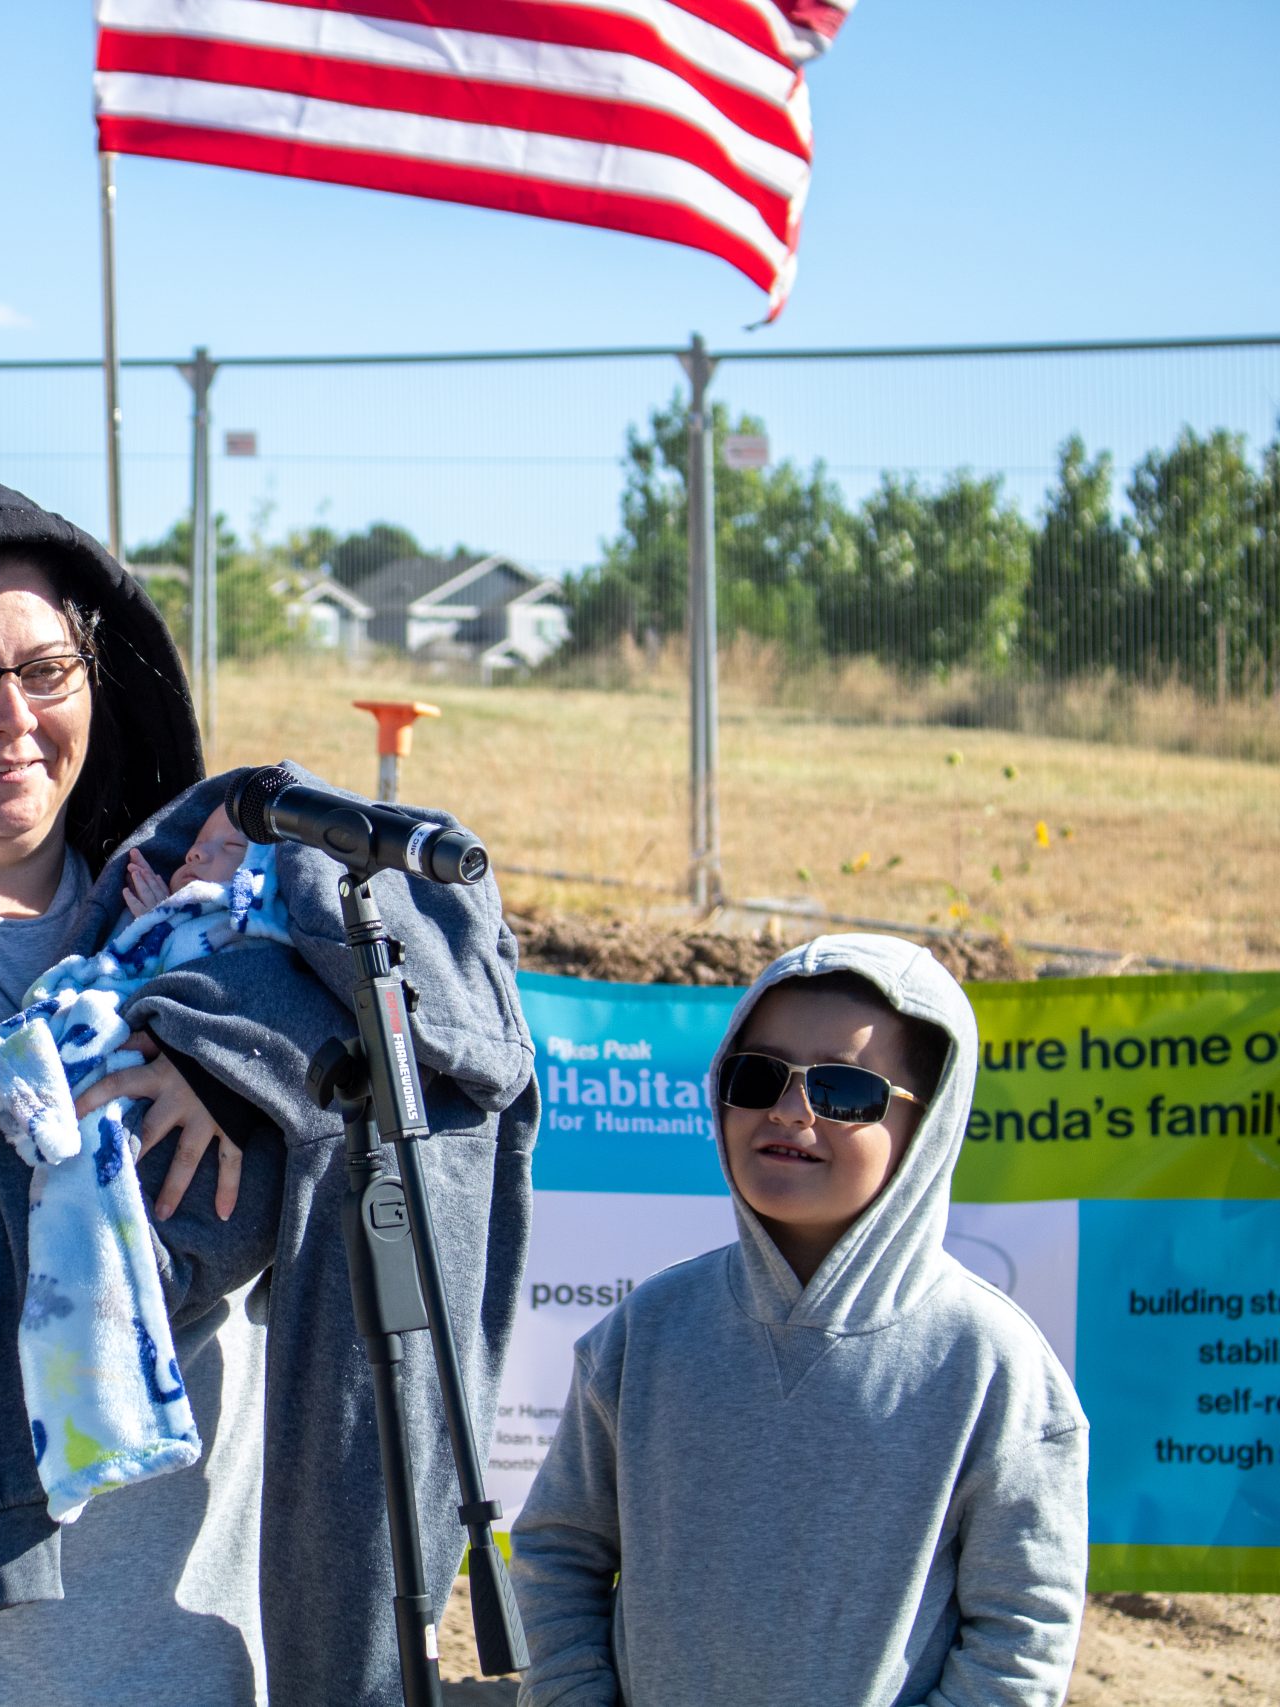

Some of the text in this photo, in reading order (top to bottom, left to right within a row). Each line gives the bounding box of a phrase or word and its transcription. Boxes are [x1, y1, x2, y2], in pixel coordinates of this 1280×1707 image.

[410, 838, 420, 856] MIC
[547, 1036, 652, 1062] Pikes Peak
[977, 1026, 1280, 1071] ure home o
[548, 1108, 716, 1140] for Humanity
[1146, 1094, 1280, 1146] famil
[531, 1278, 634, 1310] possi
[1129, 1287, 1280, 1321] building st
[1197, 1386, 1280, 1415] self-r
[496, 1431, 533, 1446] loan
[1155, 1435, 1274, 1471] through
